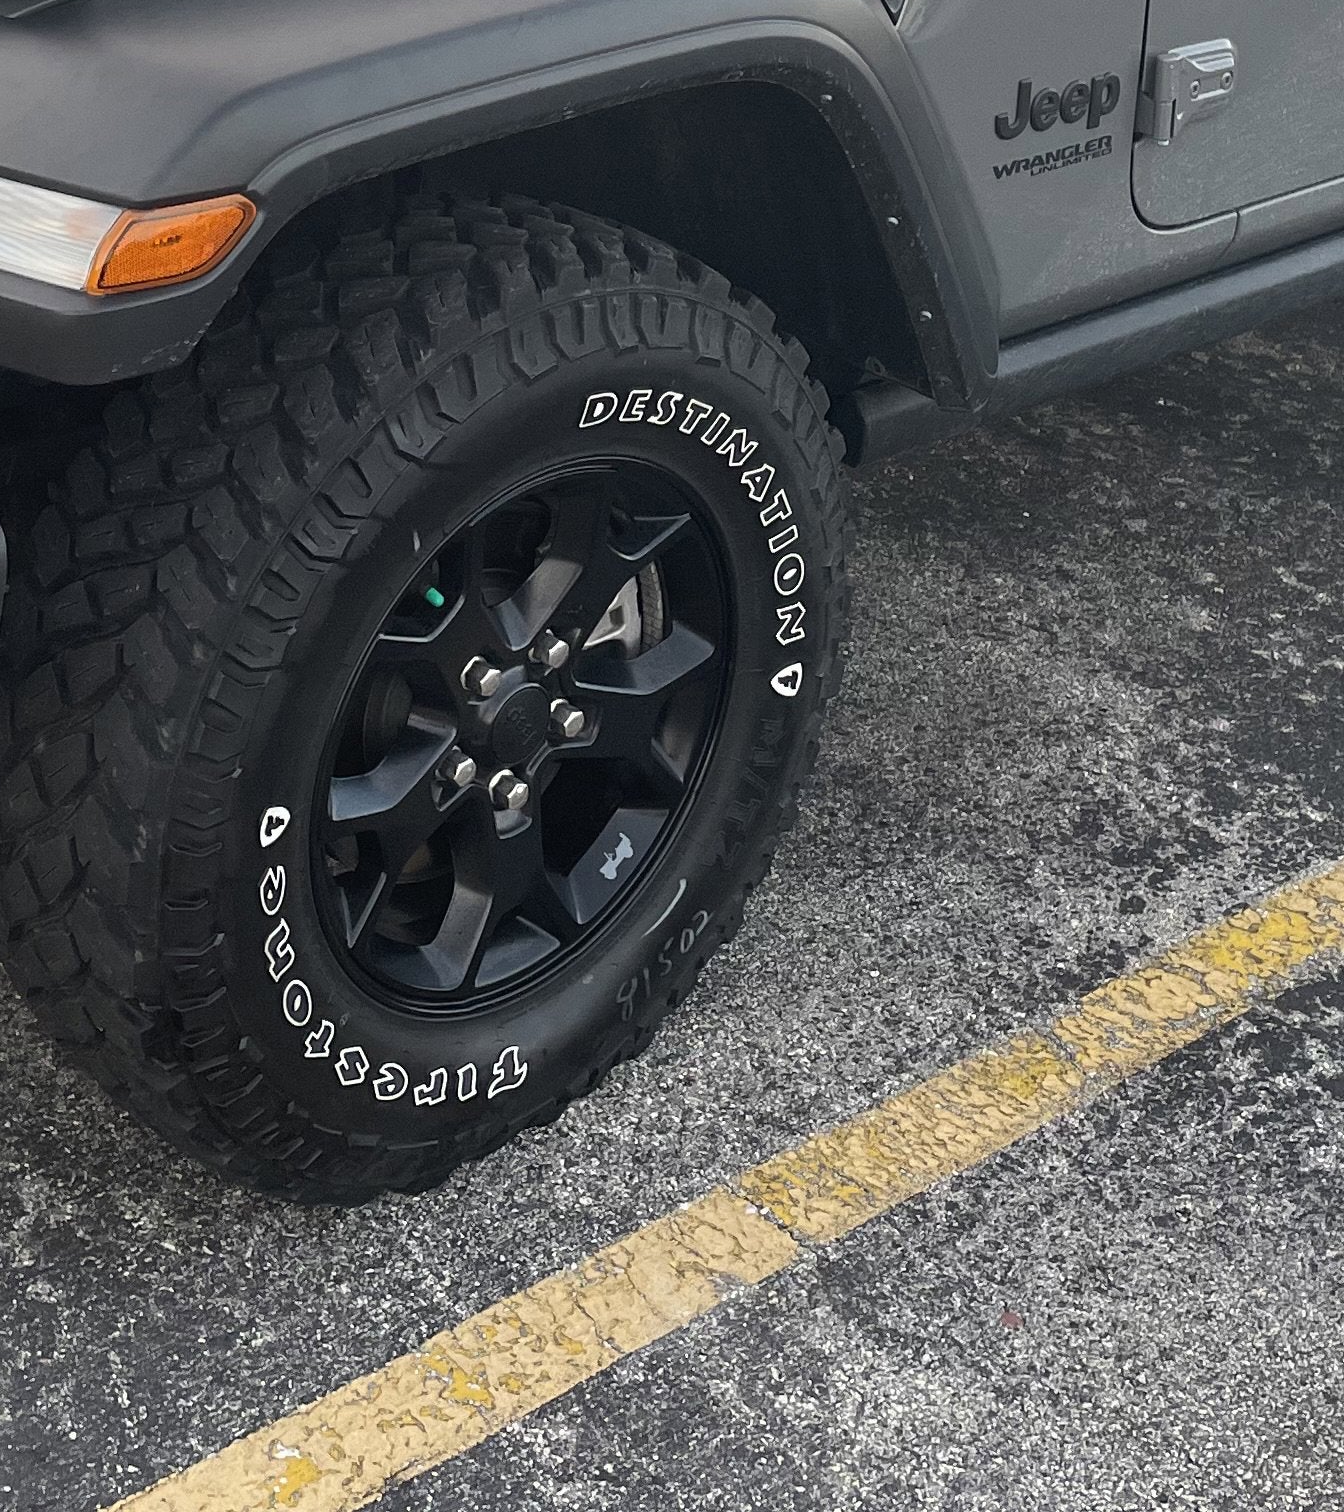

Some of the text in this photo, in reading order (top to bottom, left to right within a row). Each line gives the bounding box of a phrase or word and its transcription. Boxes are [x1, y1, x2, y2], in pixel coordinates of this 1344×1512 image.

[994, 72, 1121, 141] Jeep
[993, 135, 1113, 180] WRANGLER
[1030, 148, 1113, 177] UNLIMITED
[579, 389, 806, 646] DESTINATION
[260, 865, 528, 1106] Firestone
